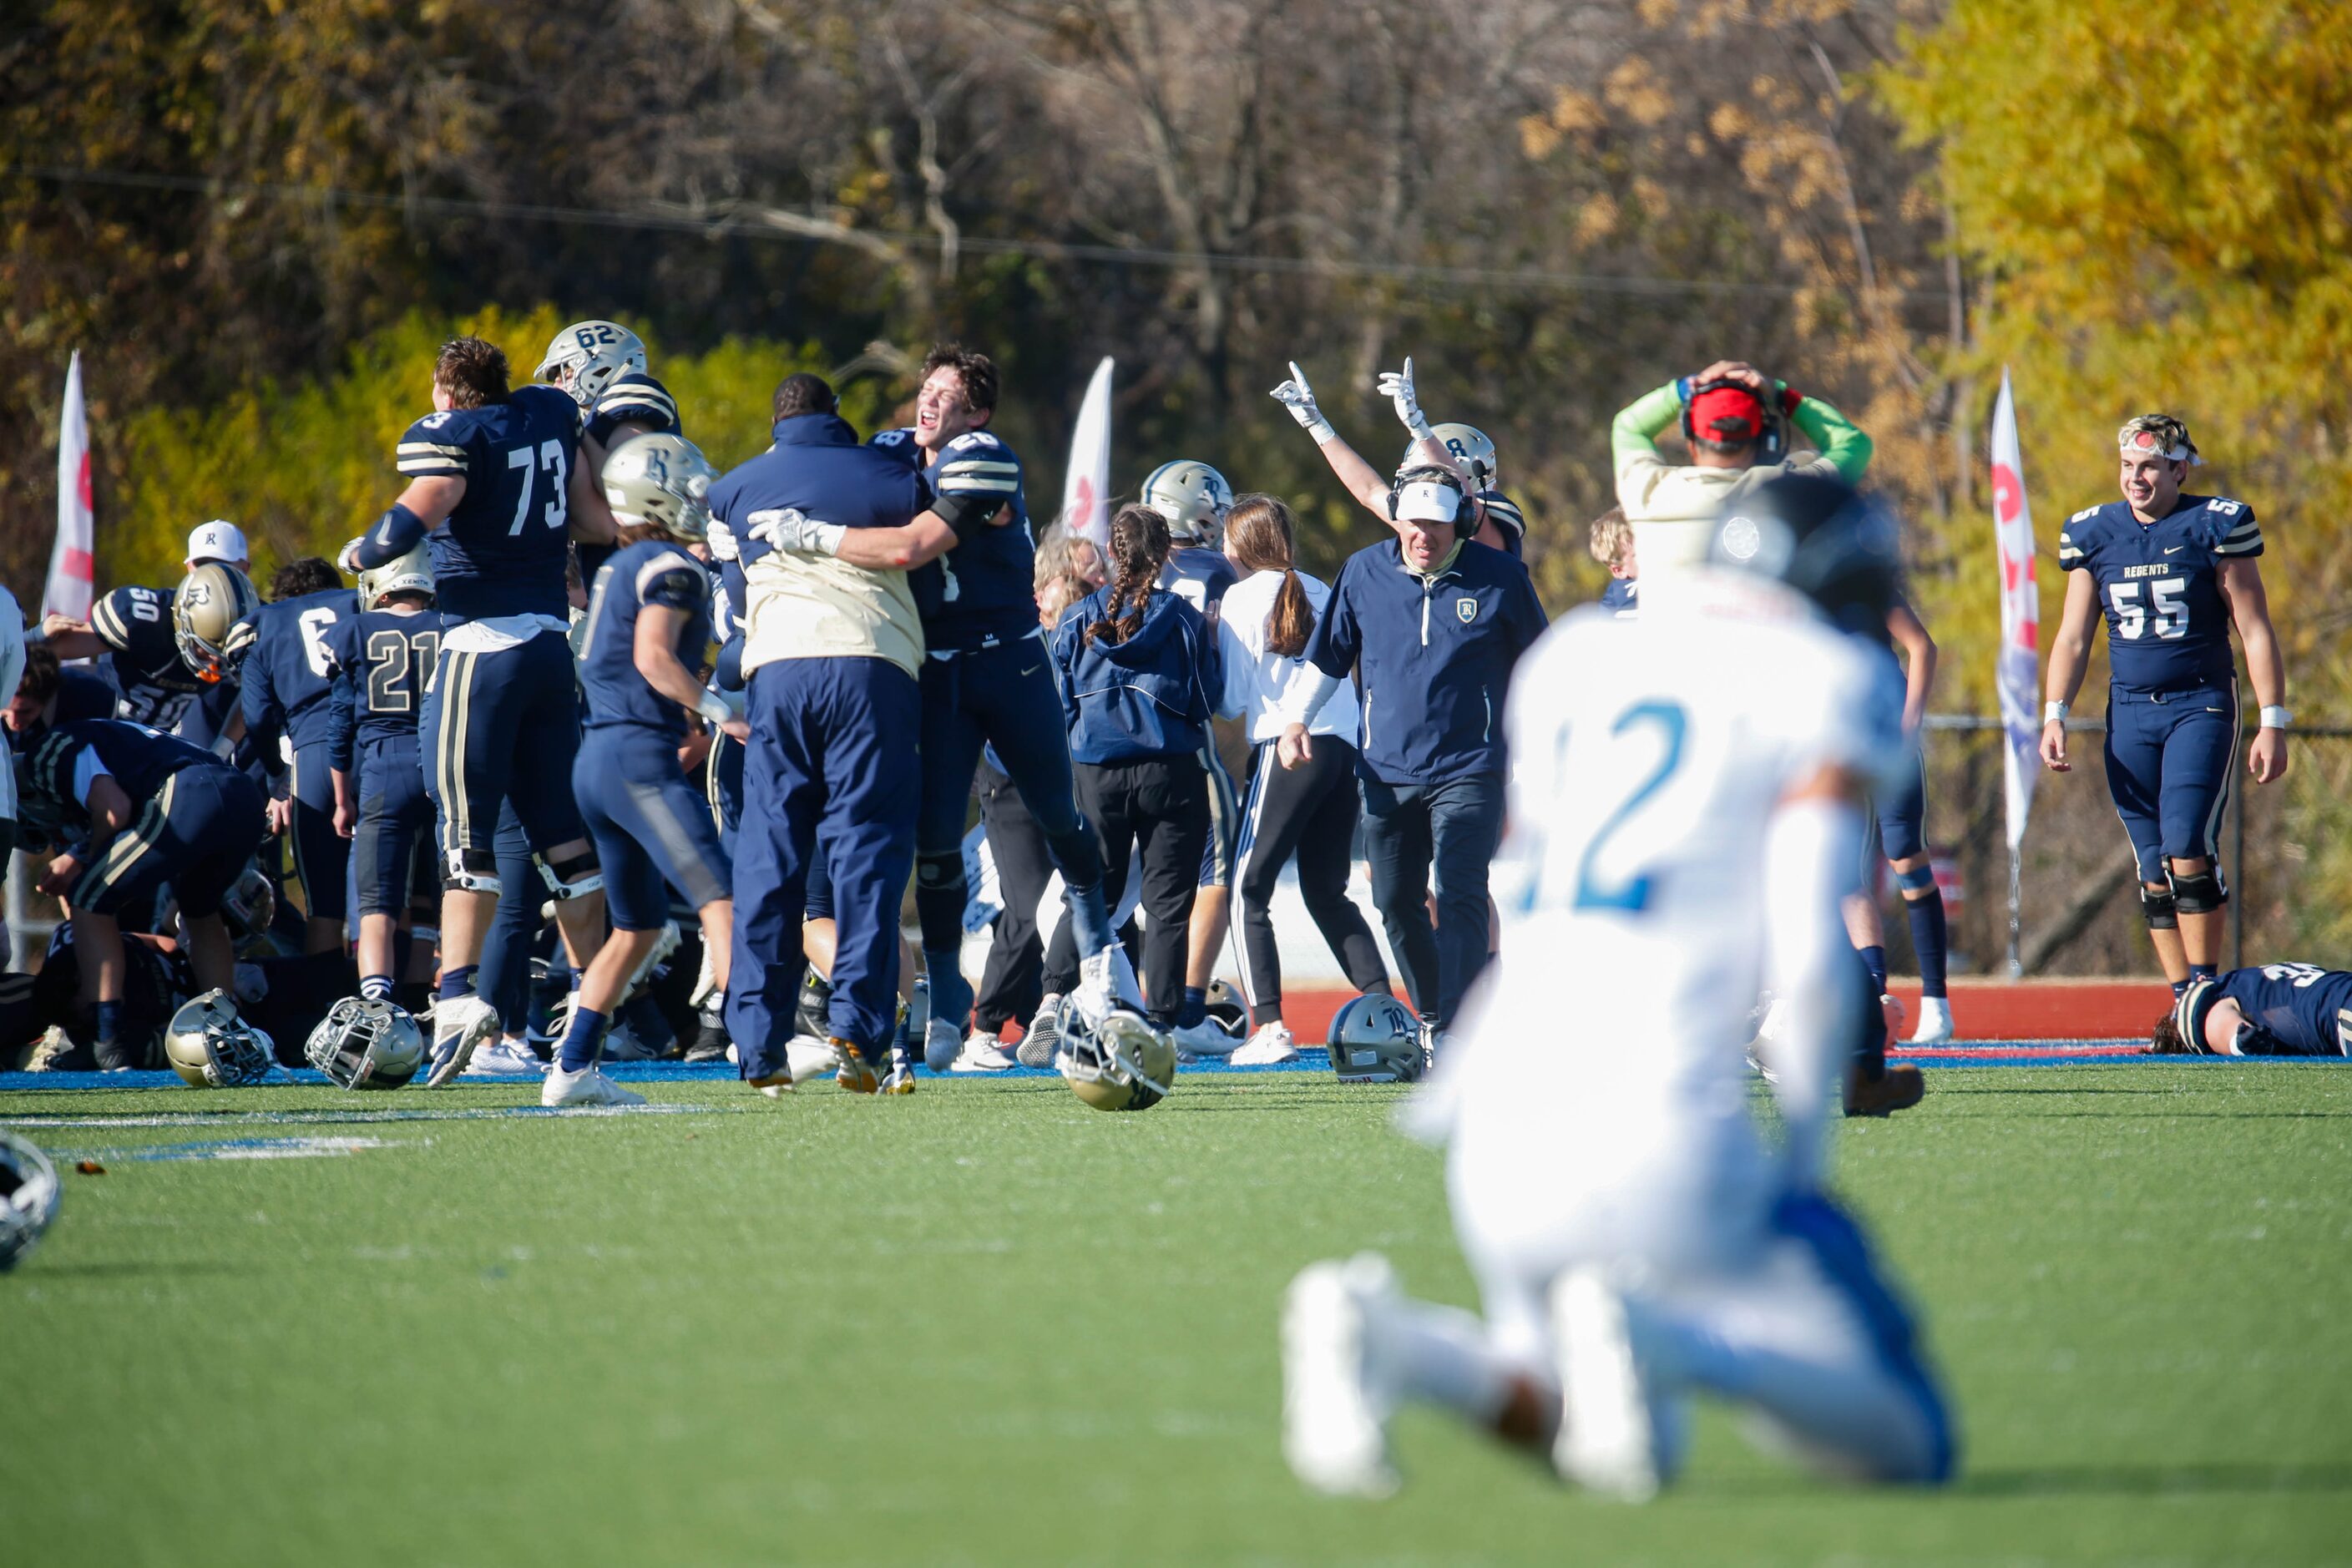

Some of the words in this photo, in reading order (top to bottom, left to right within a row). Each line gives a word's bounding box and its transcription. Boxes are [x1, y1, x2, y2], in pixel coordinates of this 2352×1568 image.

[575, 325, 616, 348] 62
[1445, 438, 1468, 458] 8
[508, 438, 567, 536] 73
[1423, 489, 1430, 498] R
[205, 533, 216, 545] R
[402, 578, 429, 586] XENITH
[2123, 563, 2169, 579] REGENTS
[128, 587, 160, 623] 50
[1462, 603, 1474, 616] R
[2109, 577, 2189, 640] 55
[298, 606, 337, 678] 6
[367, 629, 441, 712] 21
[1382, 1007, 1409, 1040] R
